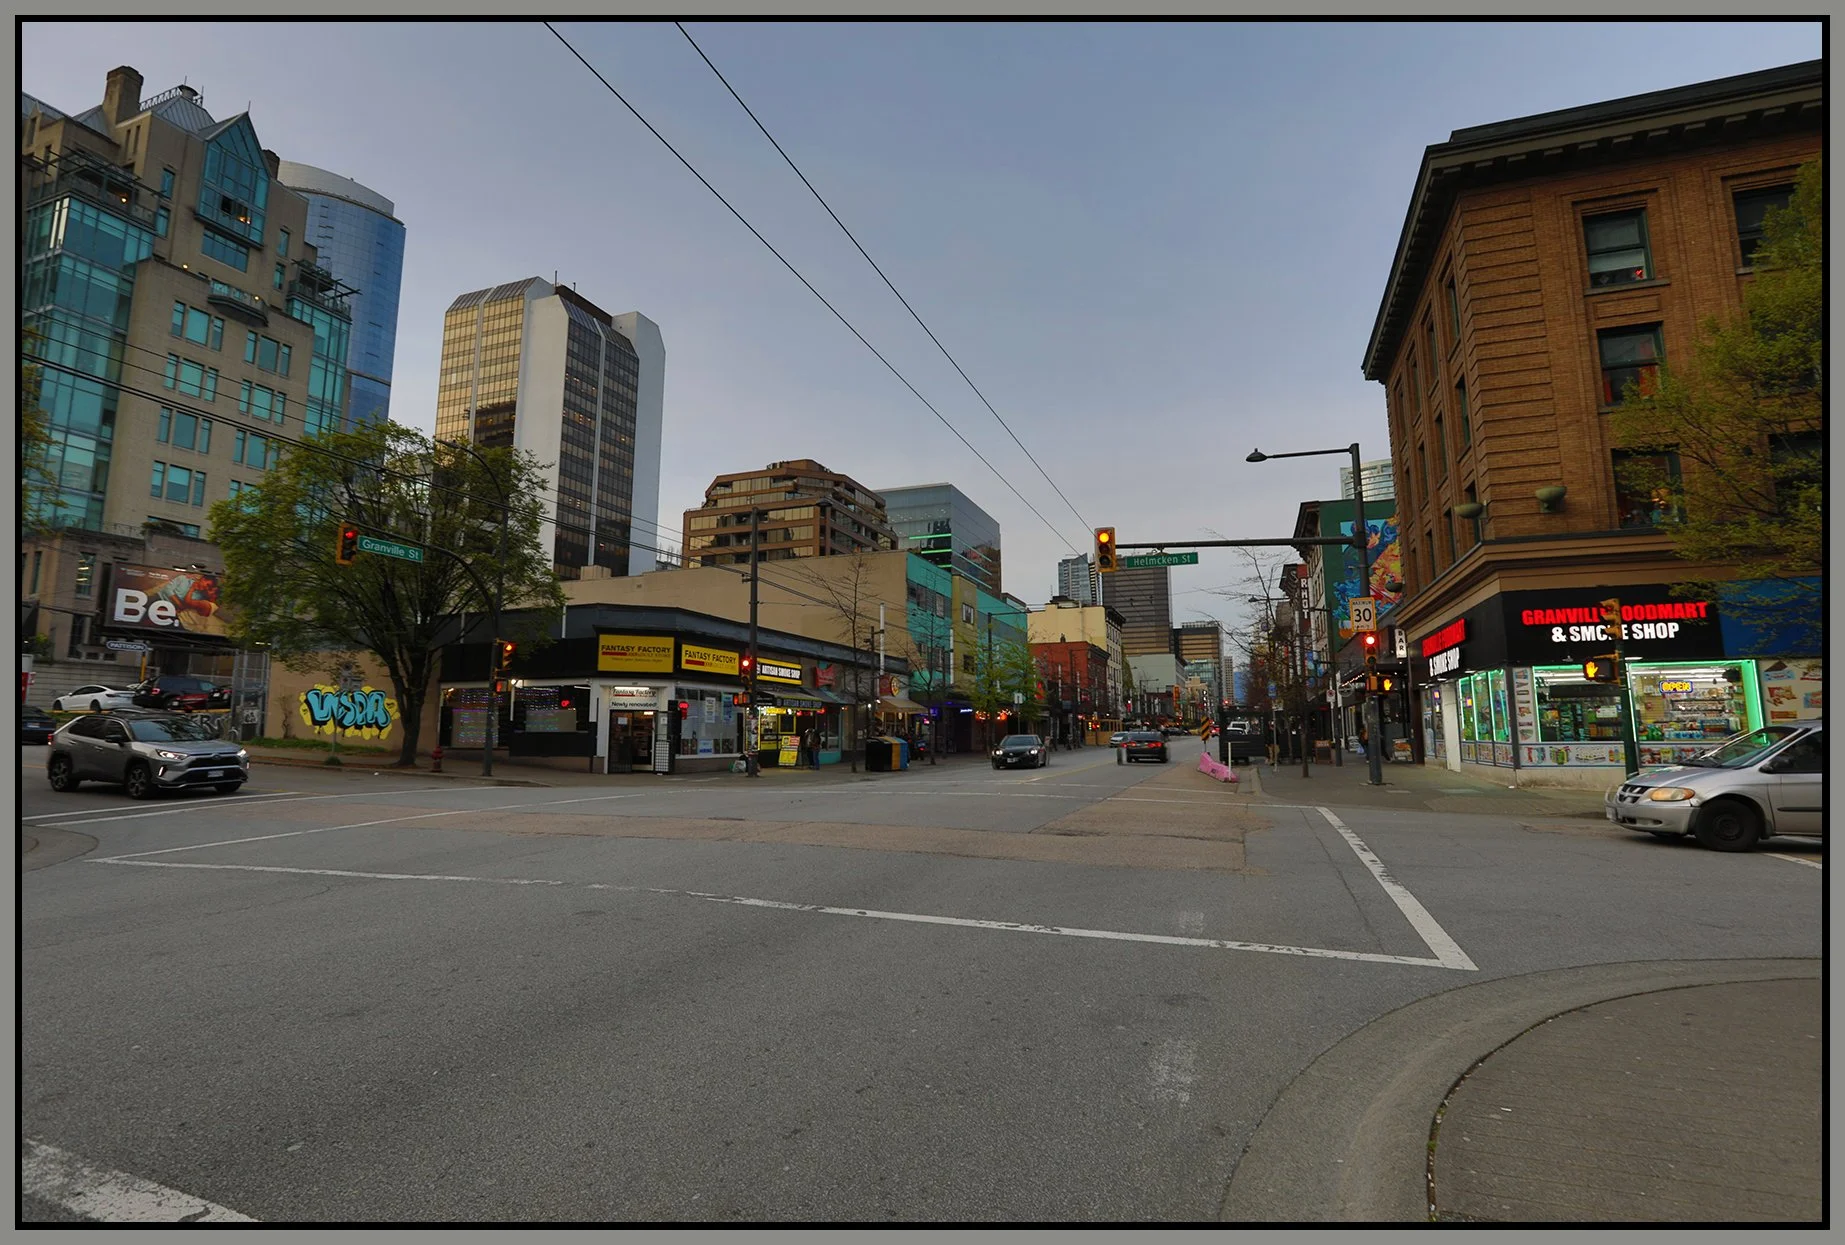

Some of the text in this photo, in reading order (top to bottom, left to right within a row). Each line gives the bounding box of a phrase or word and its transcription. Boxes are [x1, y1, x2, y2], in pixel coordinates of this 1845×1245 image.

[362, 539, 419, 559] Granville St
[1134, 554, 1191, 566] Helmcken St
[114, 588, 179, 627] Be.
[1354, 607, 1372, 622] 30
[1621, 602, 1708, 622] OODMART
[1551, 622, 1680, 642] & SMOE SHOP
[684, 650, 711, 661] FANTASY
[712, 654, 736, 664] FACTORY
[1662, 682, 1690, 691] OPEN
